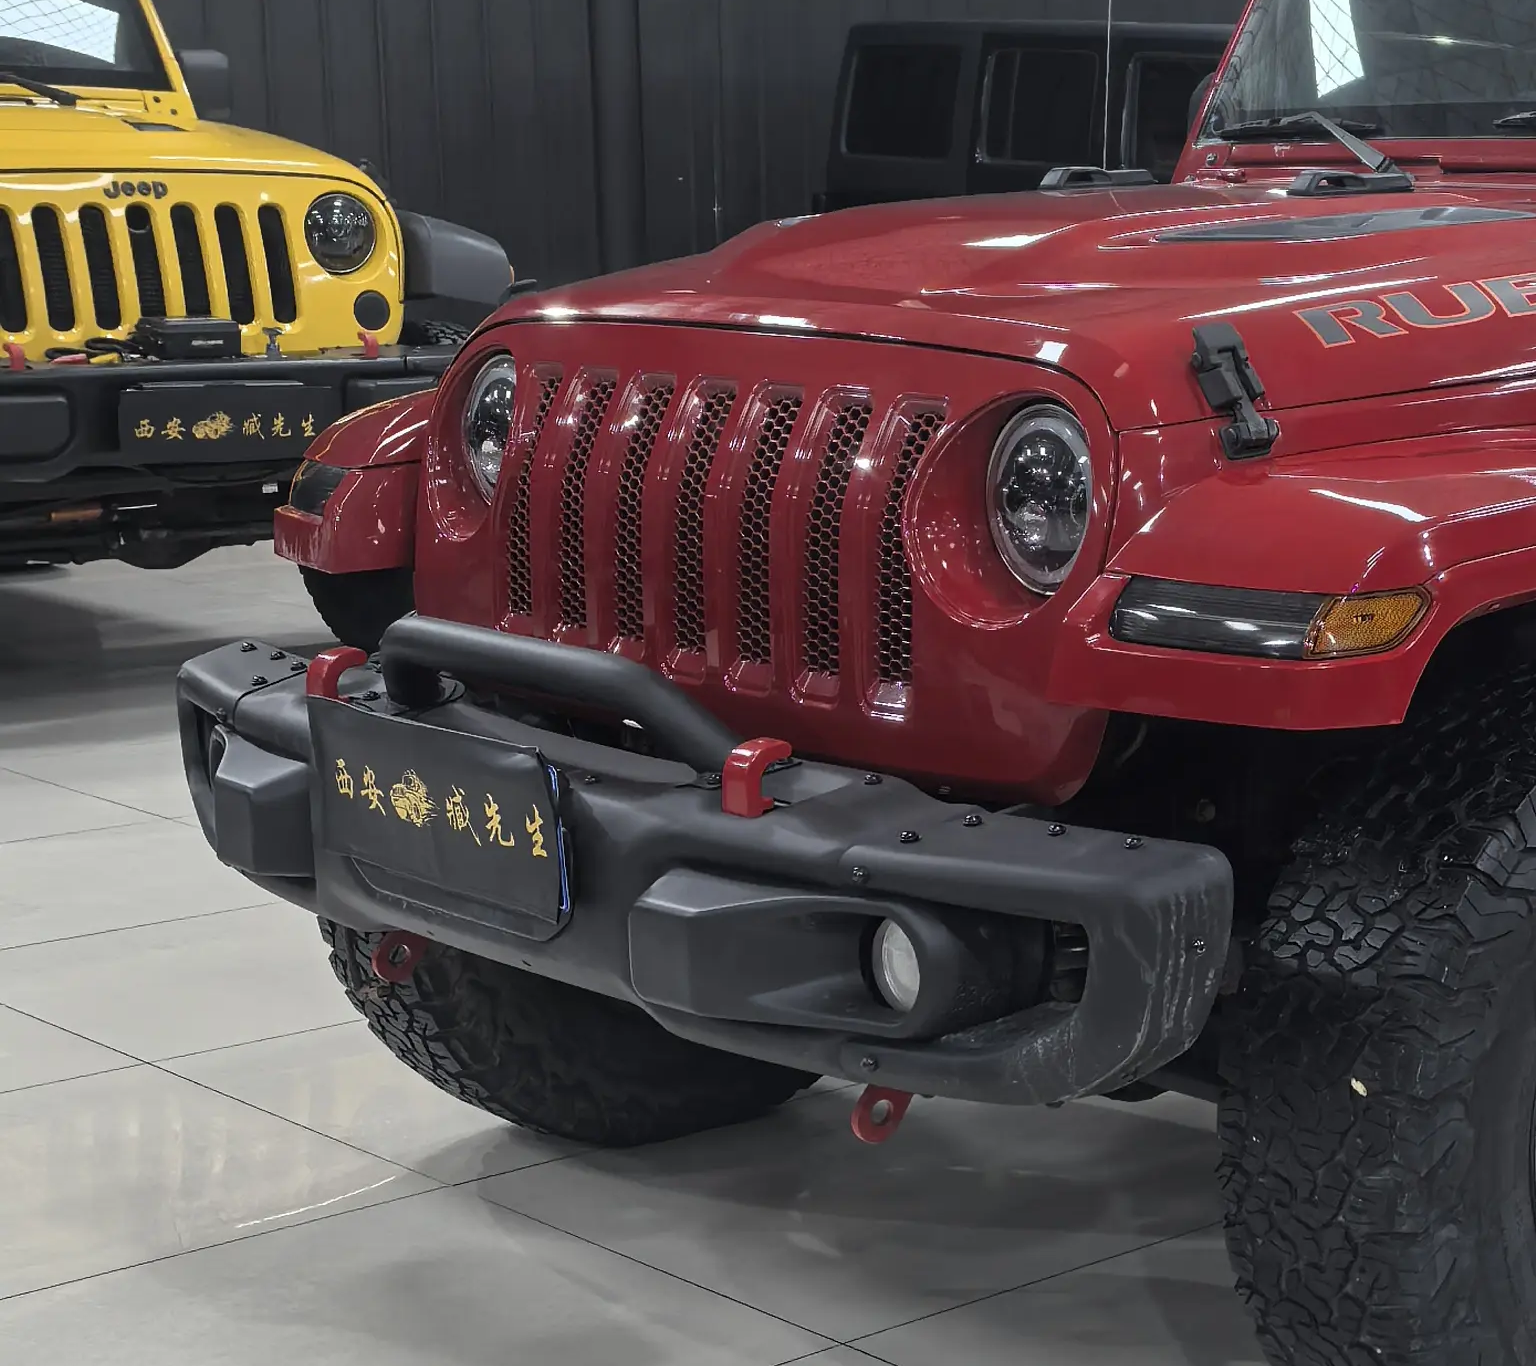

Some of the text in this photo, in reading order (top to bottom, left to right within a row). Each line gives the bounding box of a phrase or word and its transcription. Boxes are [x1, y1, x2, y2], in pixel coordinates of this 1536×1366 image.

[103, 180, 168, 200] Jeep
[134, 418, 187, 441] 西安
[335, 758, 387, 816] 西安
